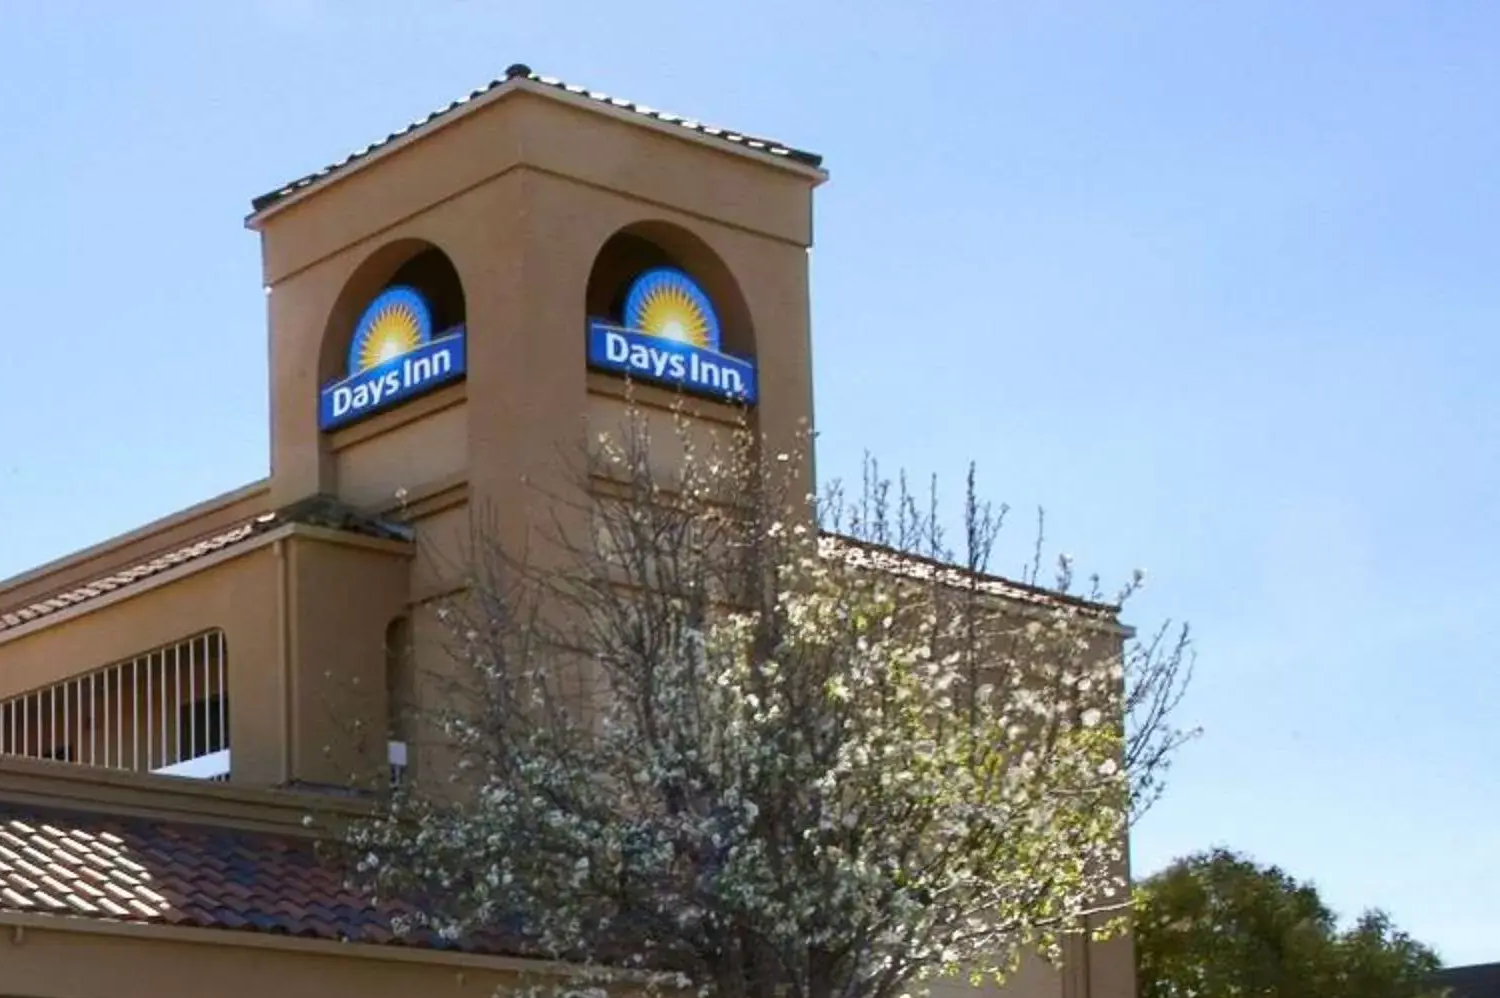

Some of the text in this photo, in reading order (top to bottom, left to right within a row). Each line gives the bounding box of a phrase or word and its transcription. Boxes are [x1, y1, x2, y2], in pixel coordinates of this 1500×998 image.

[332, 349, 451, 417] Days Inn
[606, 332, 743, 392] Days Inn
